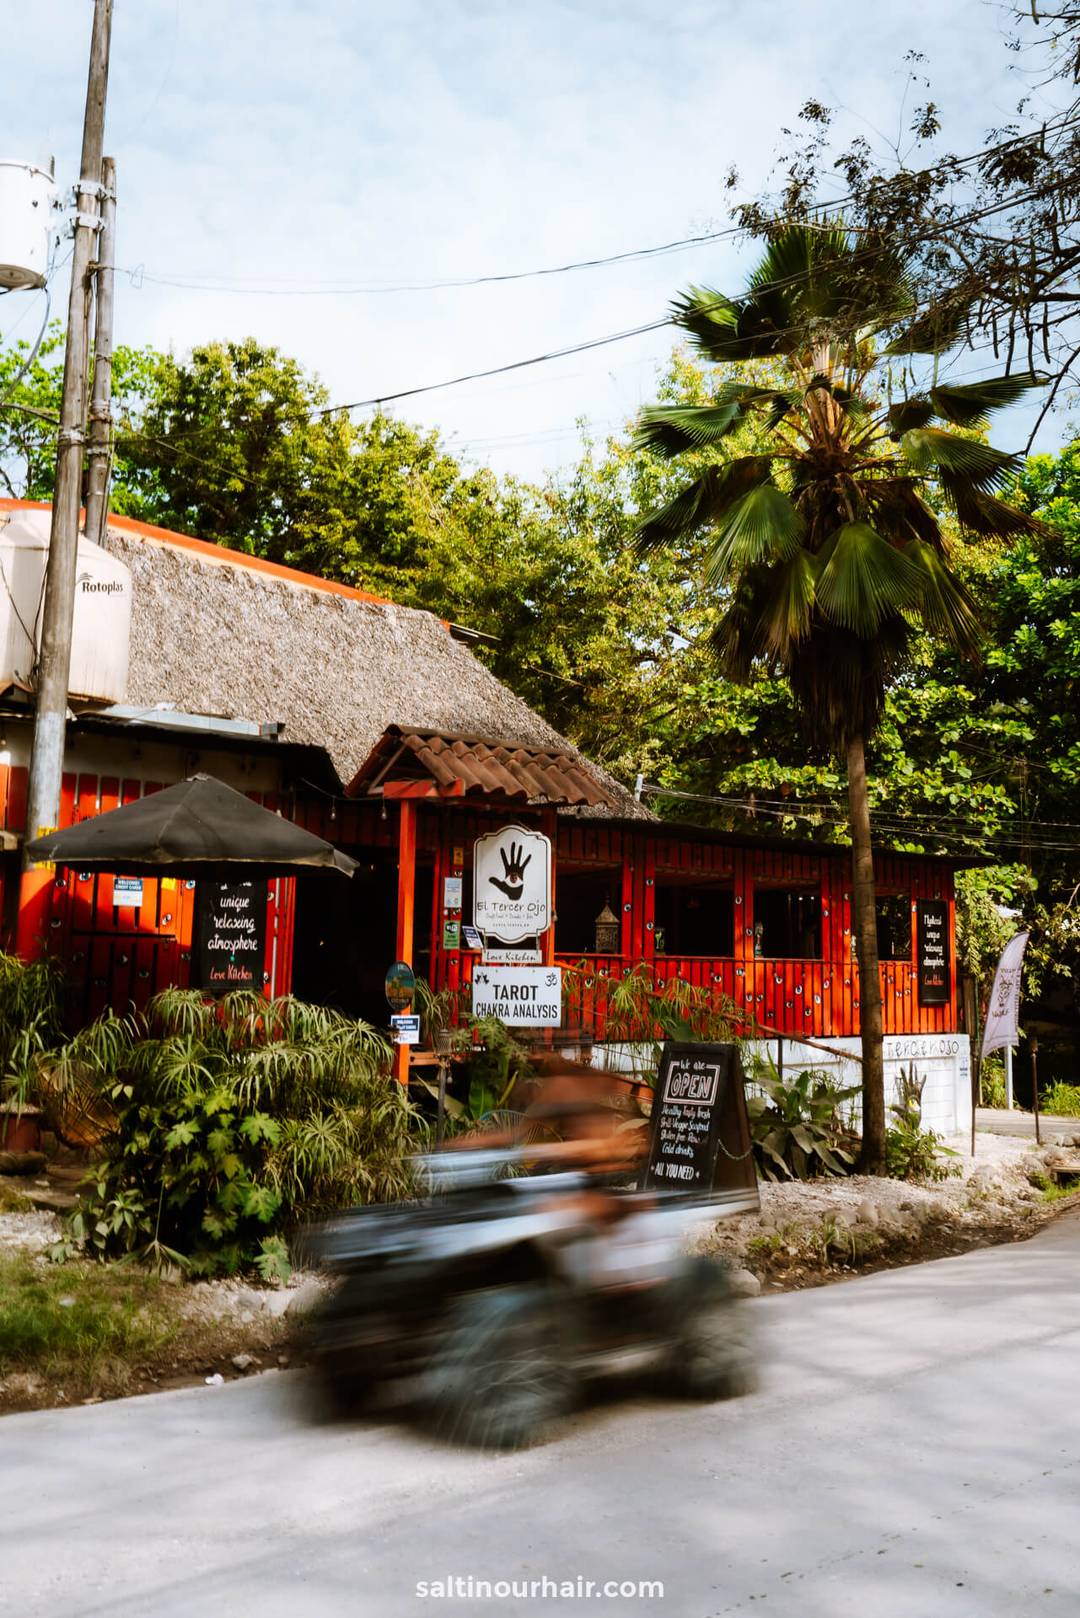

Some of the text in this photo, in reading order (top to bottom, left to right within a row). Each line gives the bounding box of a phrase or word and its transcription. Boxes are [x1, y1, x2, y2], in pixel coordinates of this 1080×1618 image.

[82, 580, 123, 595] Rotoplas
[220, 895, 250, 912] unique
[477, 901, 488, 911] El
[491, 902, 524, 912] Tercer
[527, 900, 546, 916] Ojo
[213, 912, 256, 933] relaxing
[207, 933, 258, 955] atmosphere
[505, 951, 536, 961] Kitchen
[210, 967, 226, 980] Love
[492, 984, 539, 1001] TAROT
[476, 1002, 558, 1019] CHAKRA ANALYSIS
[670, 1072, 712, 1098] OPEN
[654, 1161, 694, 1180] ALL YOU NEED
